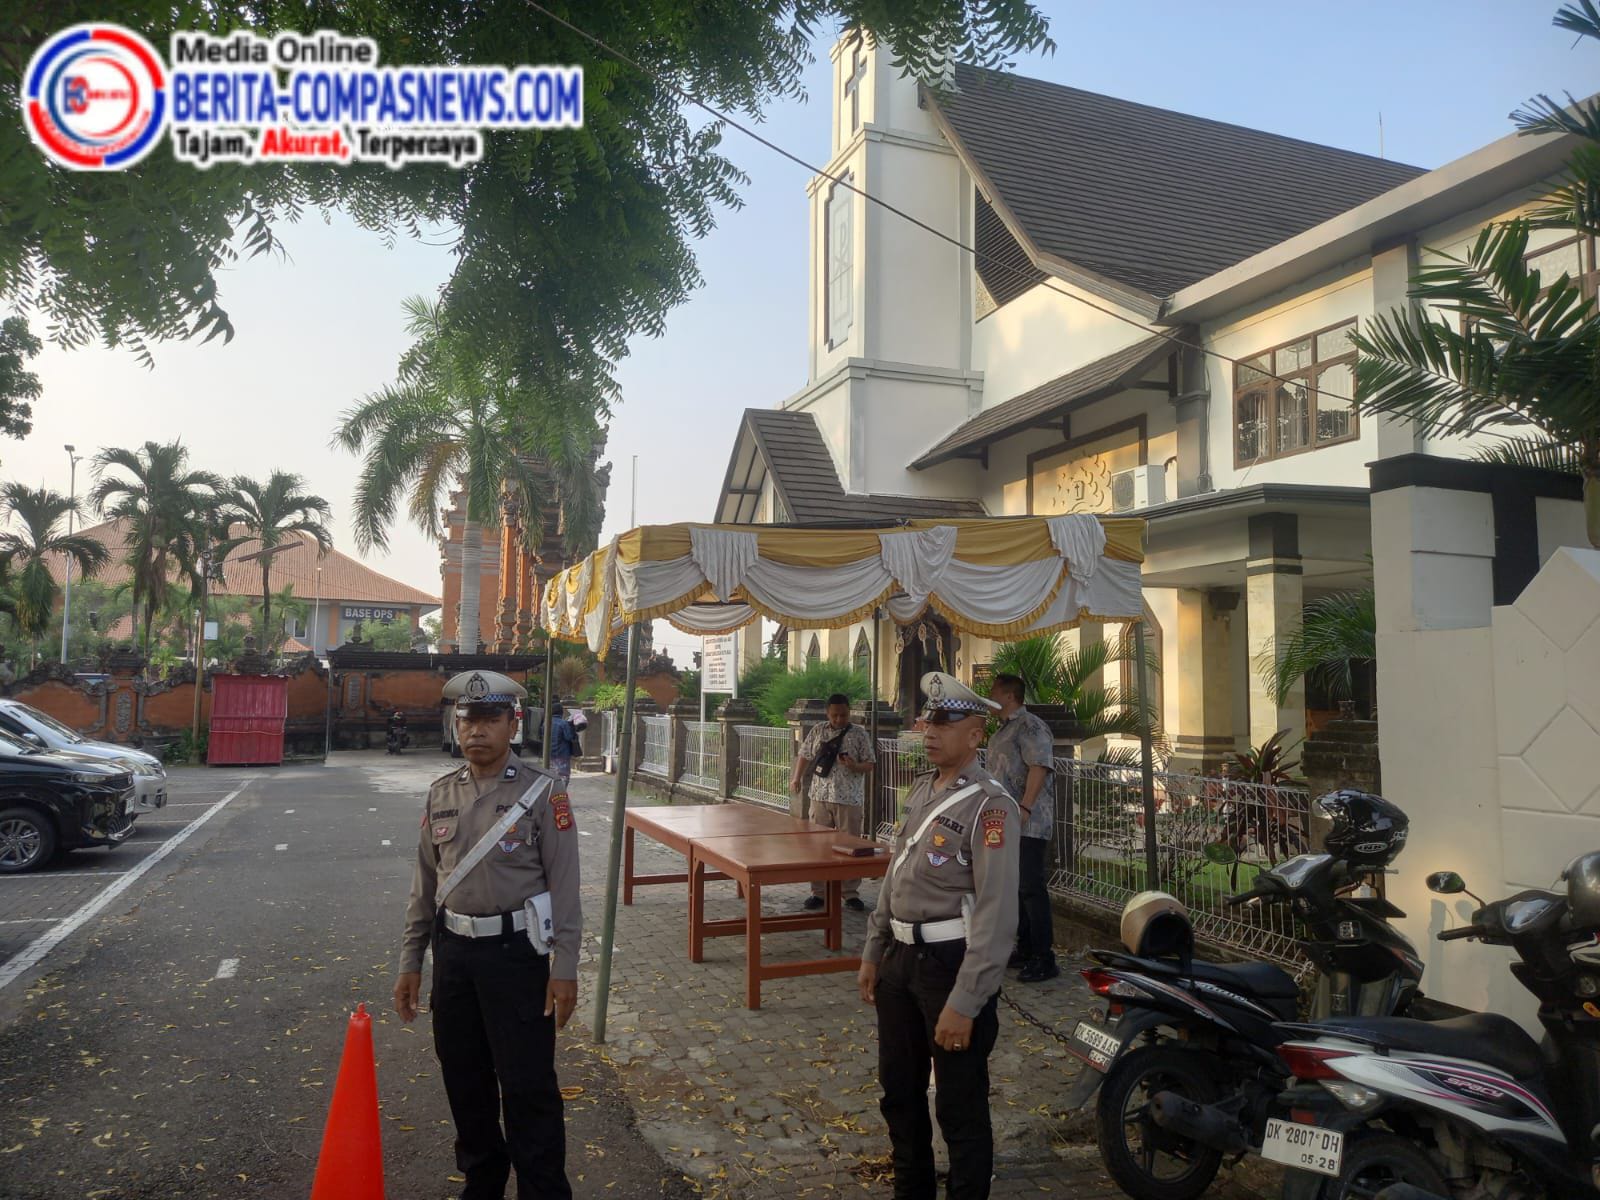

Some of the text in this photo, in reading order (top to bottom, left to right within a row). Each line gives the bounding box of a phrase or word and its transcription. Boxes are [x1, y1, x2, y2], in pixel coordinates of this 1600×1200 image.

[345, 608, 393, 619] BASE OPS
[1101, 1038, 1119, 1056] AAS
[1266, 1123, 1340, 1153] DK 2807 DH
